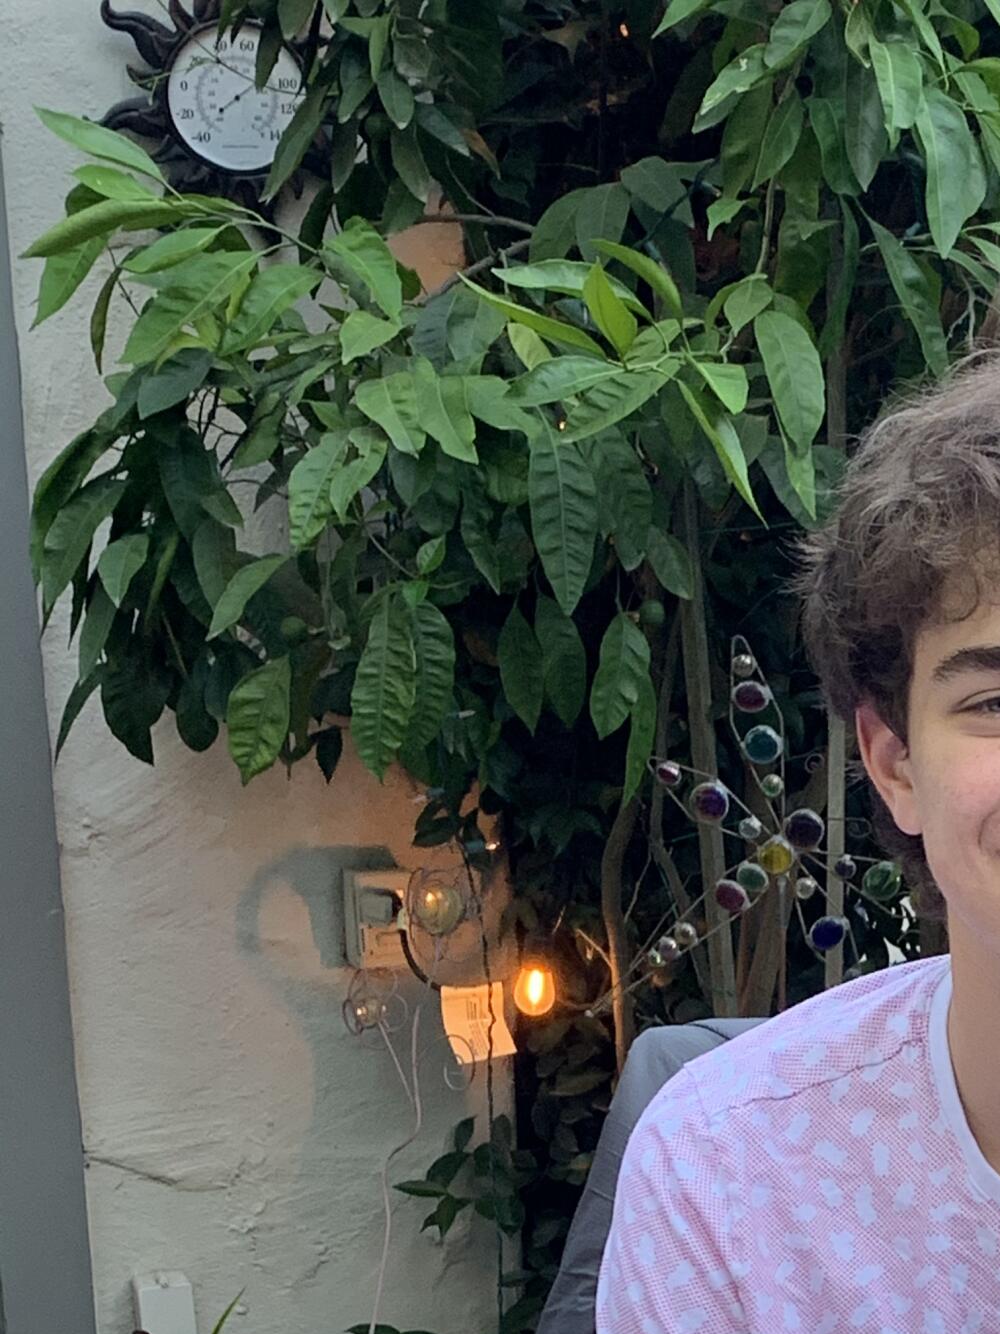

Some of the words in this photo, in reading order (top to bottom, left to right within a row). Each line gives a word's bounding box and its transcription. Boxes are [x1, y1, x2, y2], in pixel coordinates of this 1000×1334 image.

[239, 39, 255, 52] 60
[180, 80, 188, 91] 0
[278, 78, 298, 89] 100
[176, 108, 194, 120] -20
[191, 131, 211, 143] -40
